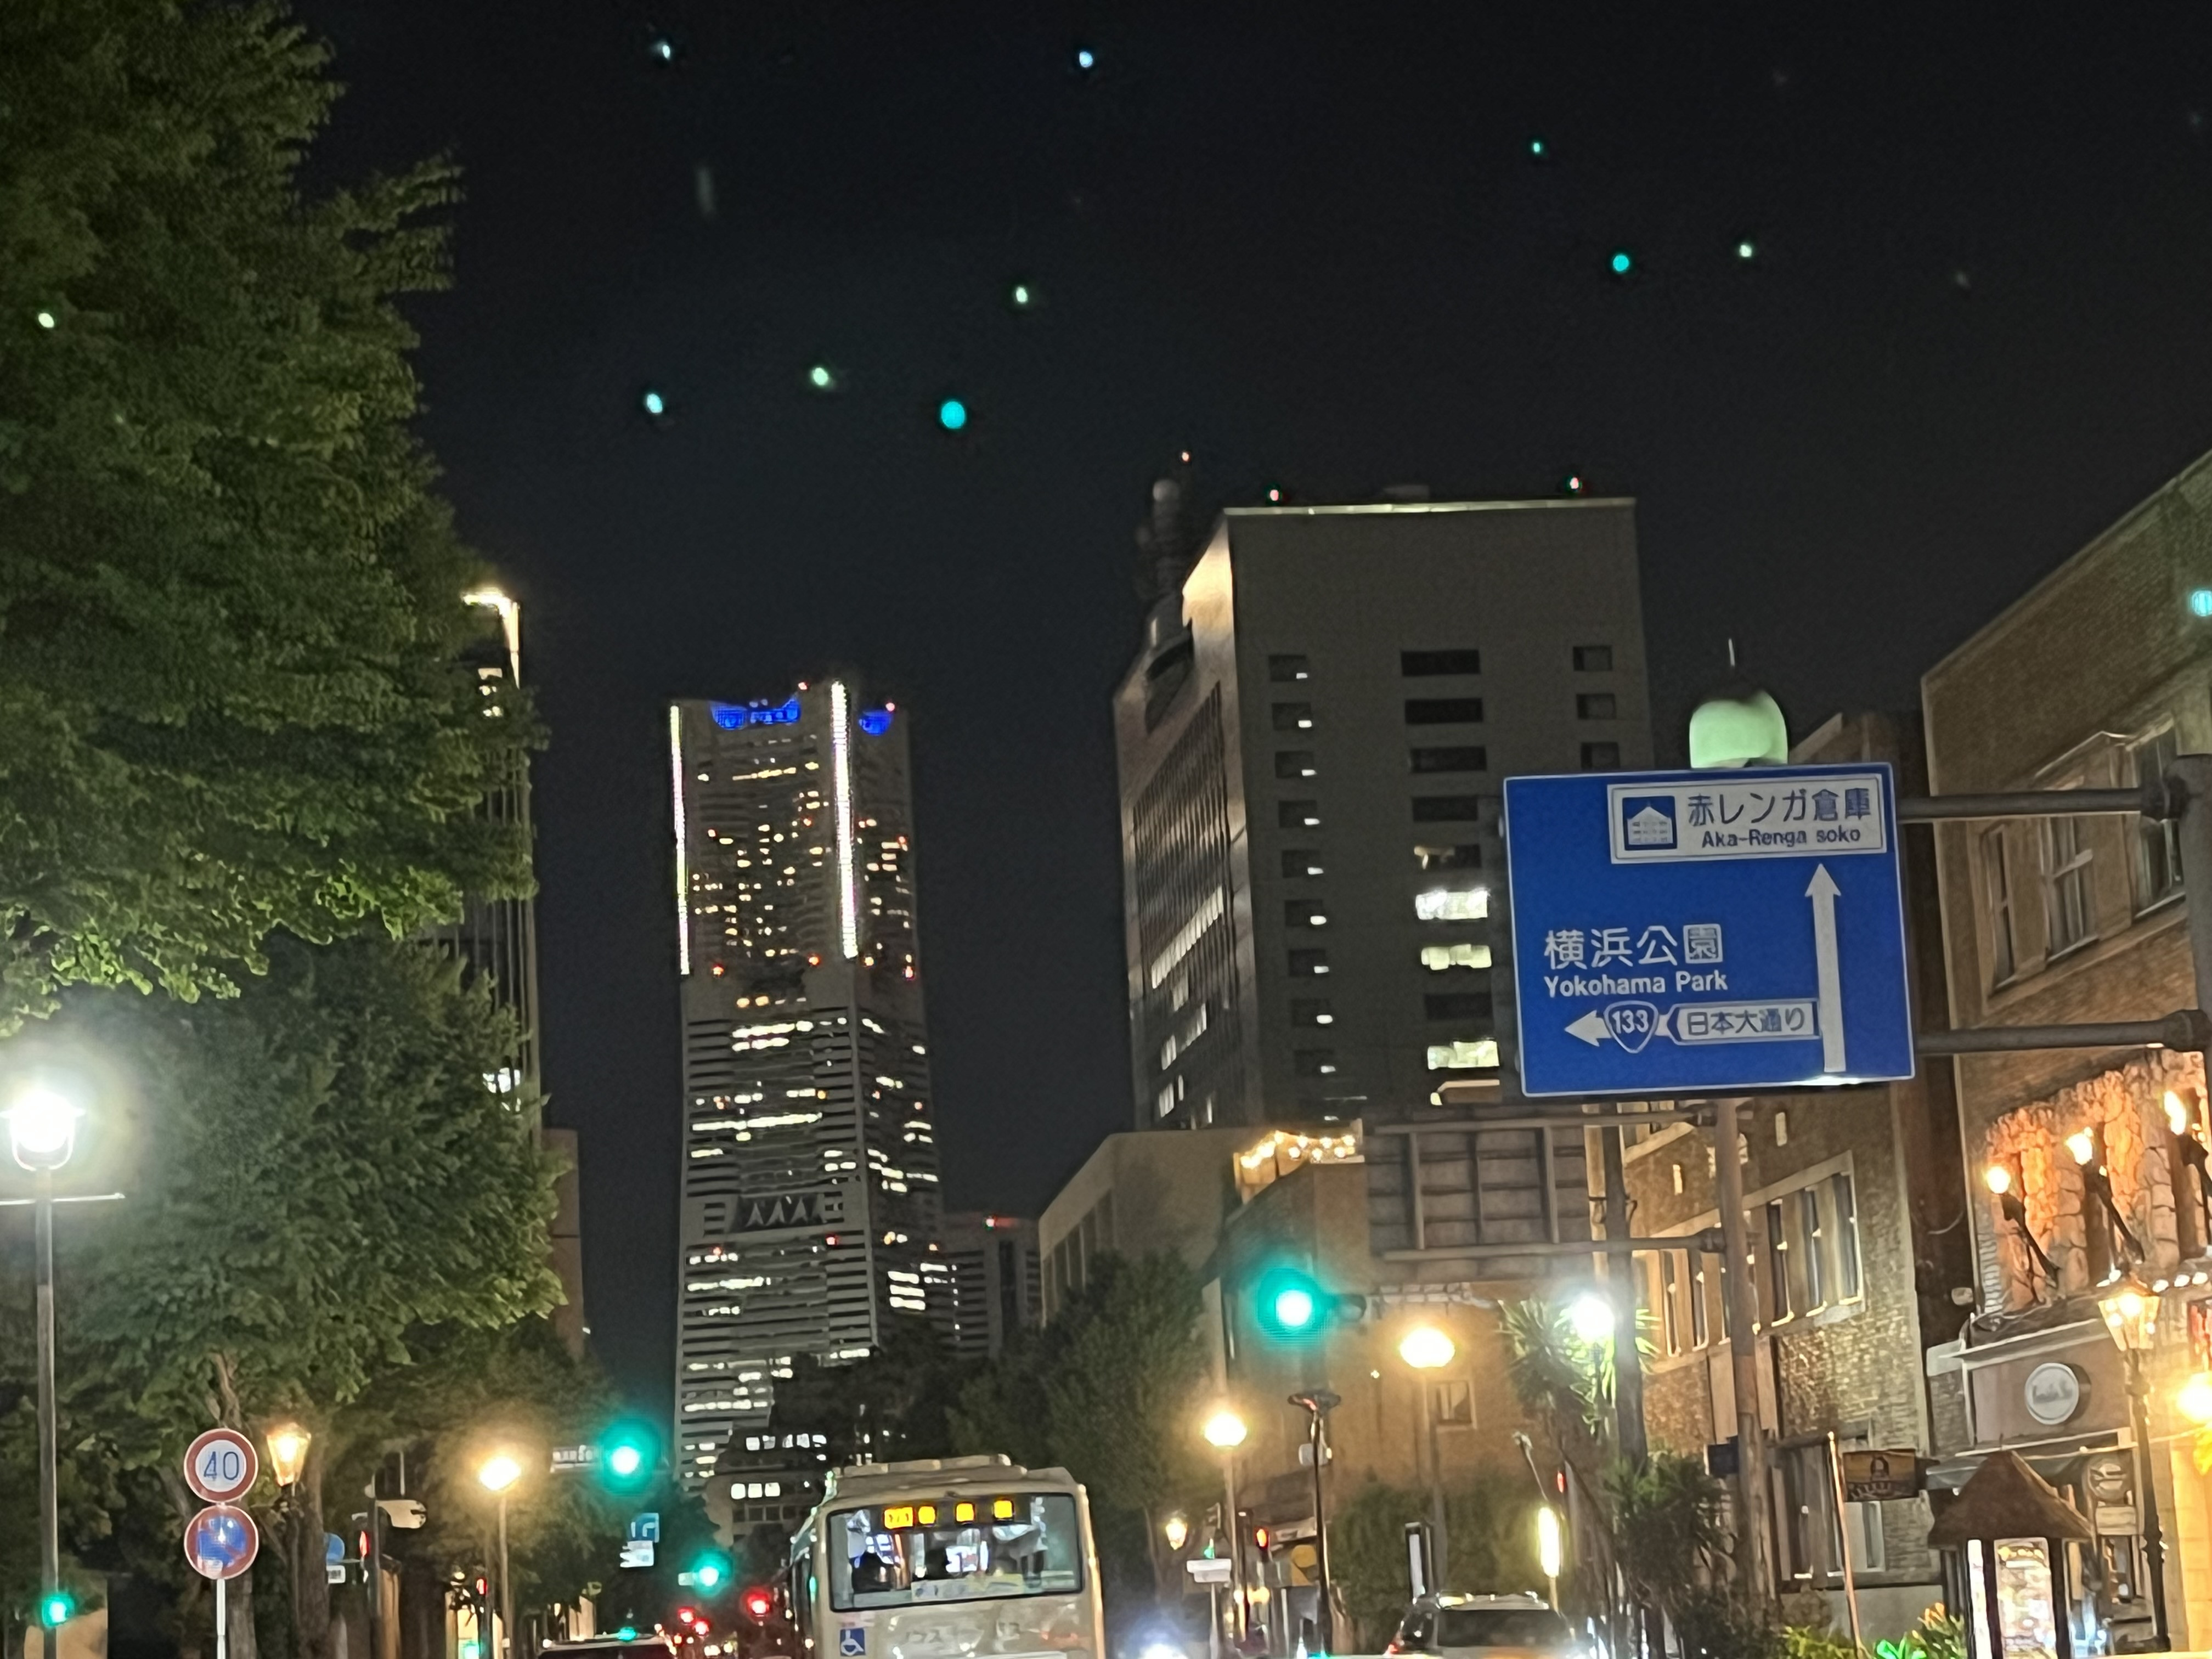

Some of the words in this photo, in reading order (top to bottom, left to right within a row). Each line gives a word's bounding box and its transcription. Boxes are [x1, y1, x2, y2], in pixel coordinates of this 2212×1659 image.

[1688, 787, 1871, 827] 赤レンガ倉庫
[1702, 828, 1807, 848] Aka-Renga
[1816, 825, 1861, 843] soko
[1543, 923, 1723, 970] 横浜公園
[1543, 974, 1666, 998] Yokohama
[1675, 969, 1728, 992] Park
[1612, 1009, 1649, 1034] 133
[1687, 1007, 1805, 1036] 日本大通り
[204, 1451, 239, 1481] 40
